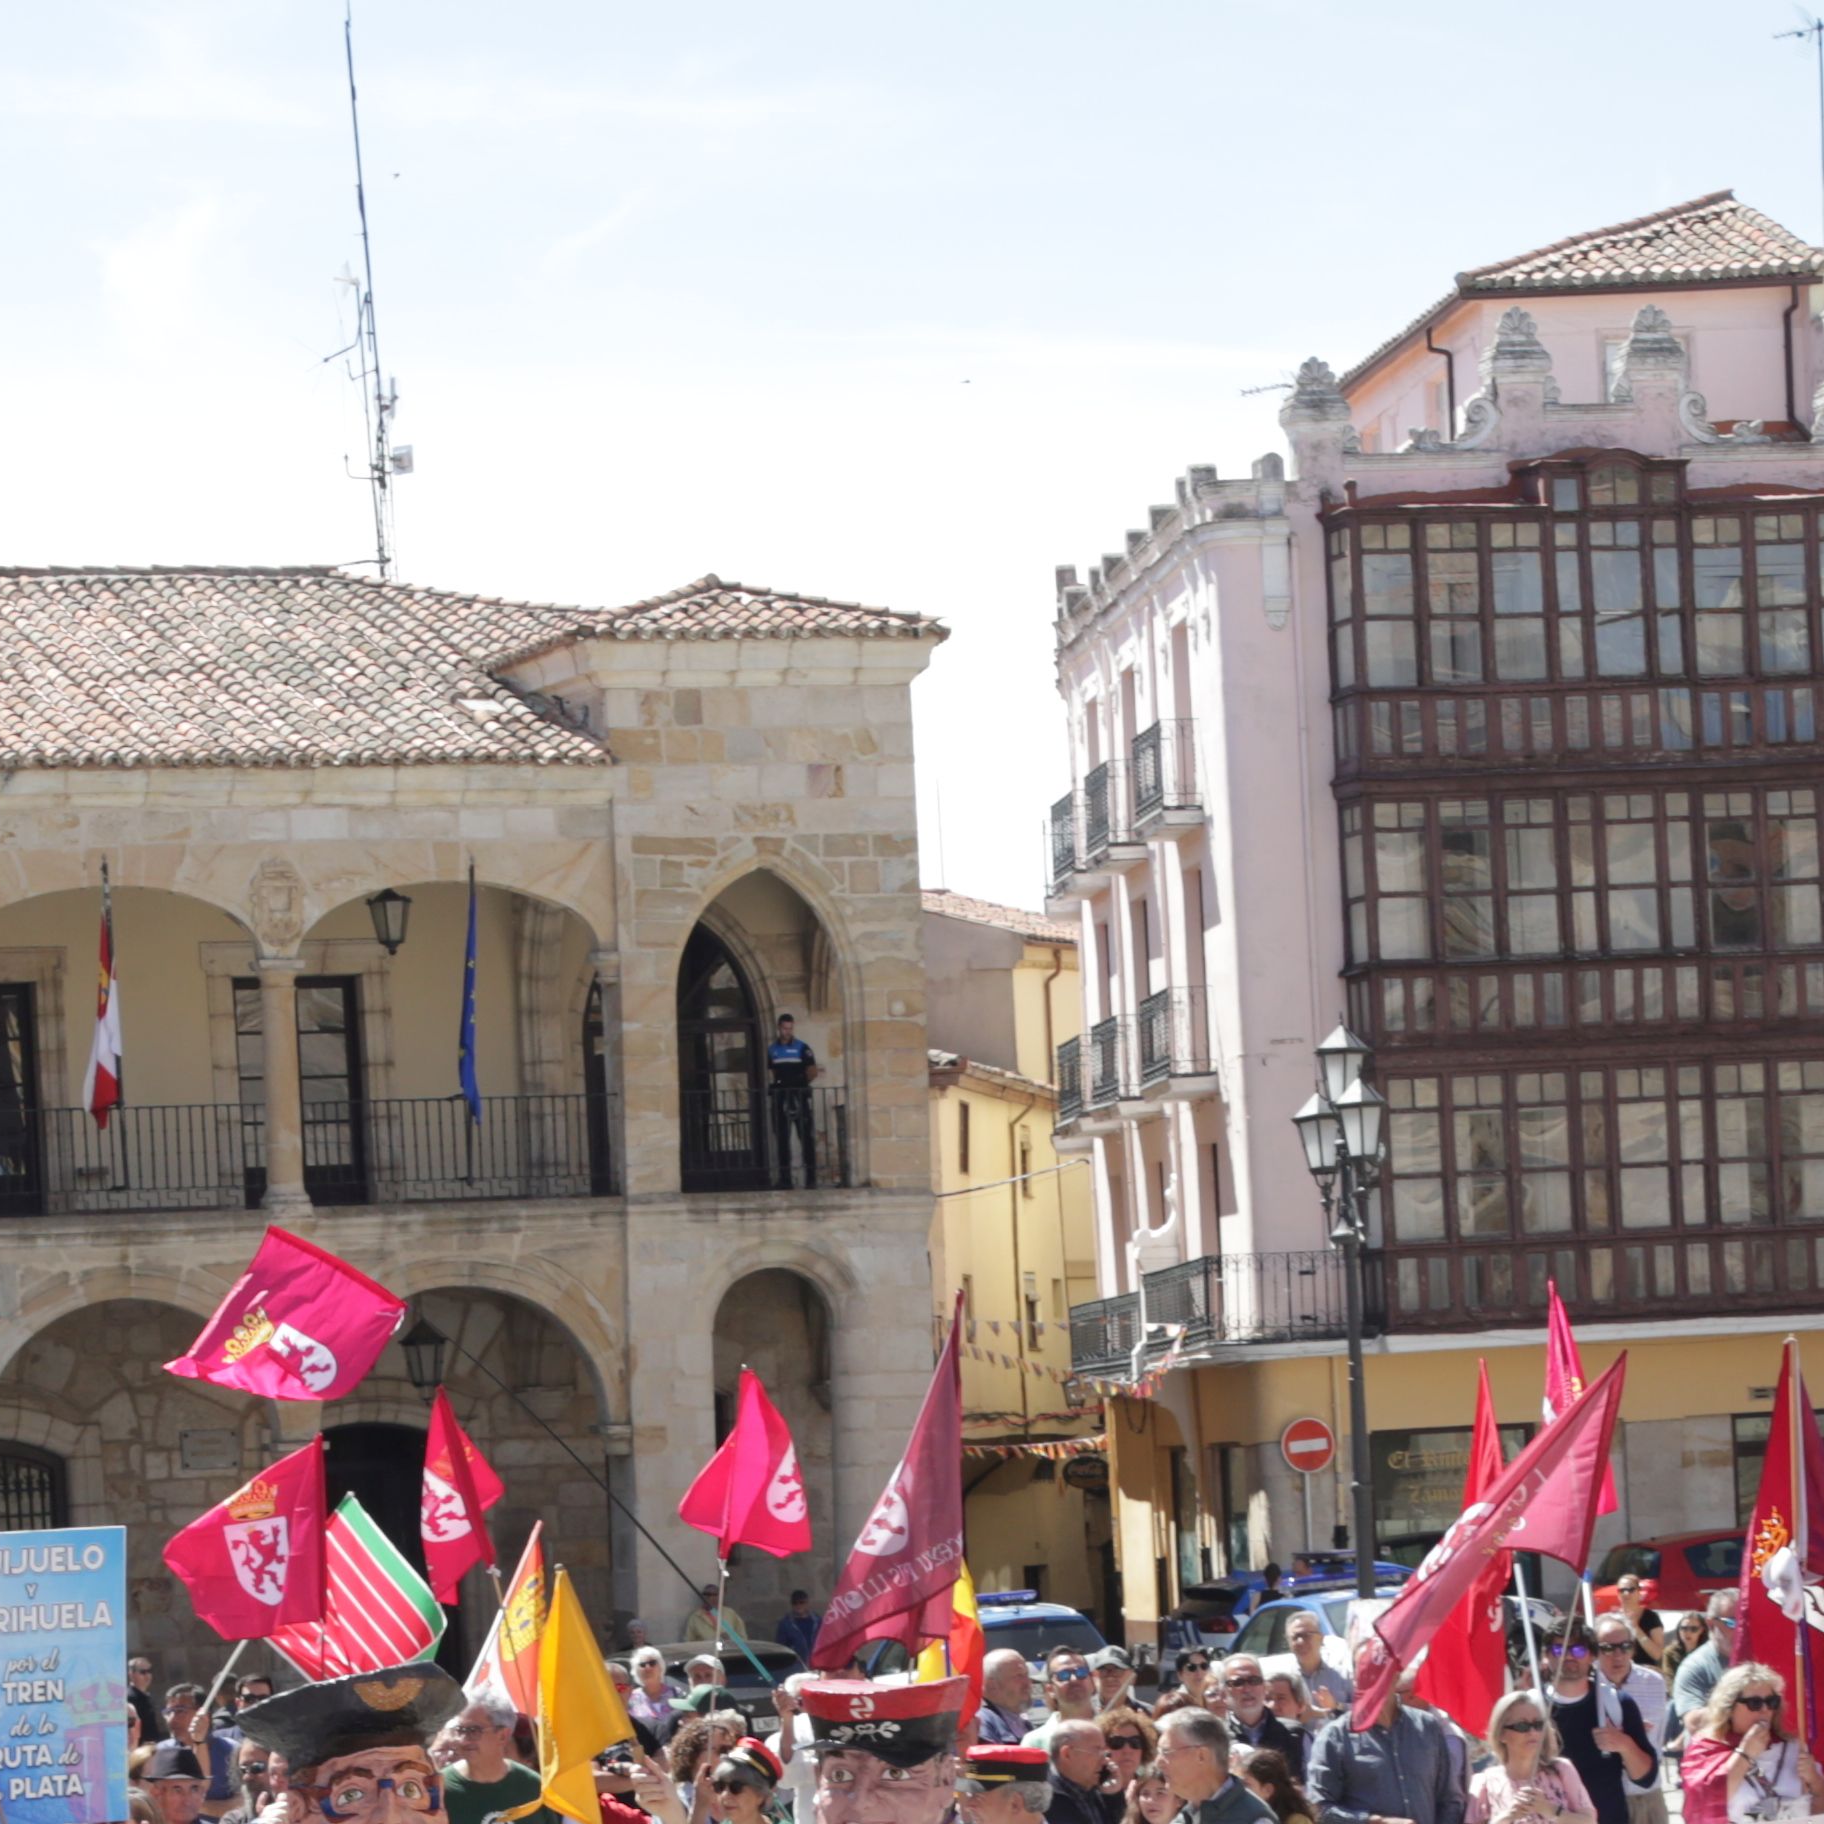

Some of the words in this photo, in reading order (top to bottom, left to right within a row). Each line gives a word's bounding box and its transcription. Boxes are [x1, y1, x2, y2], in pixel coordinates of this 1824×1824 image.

[25, 1582, 38, 1599] Y
[5, 1656, 37, 1680] por
[40, 1647, 60, 1672] el
[1, 1679, 65, 1705] TREN
[9, 1715, 33, 1738] de
[37, 1711, 56, 1735] la
[57, 1743, 81, 1767] de
[9, 1773, 85, 1800] PLATA
